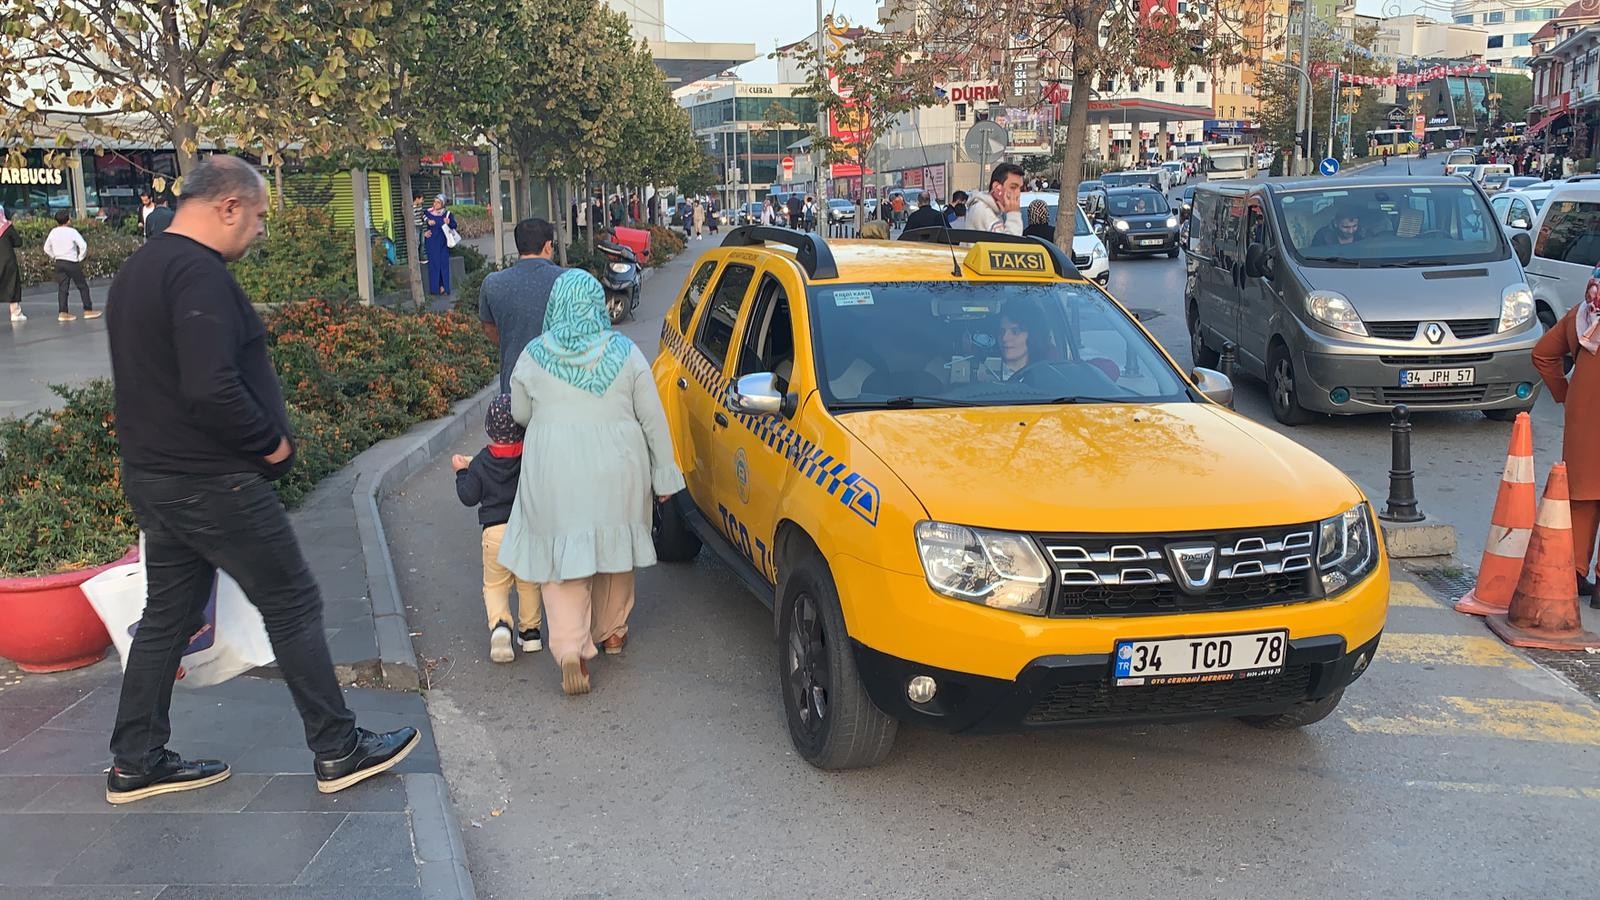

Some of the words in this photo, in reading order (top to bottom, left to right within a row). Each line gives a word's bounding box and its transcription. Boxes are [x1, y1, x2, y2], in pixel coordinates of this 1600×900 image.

[0, 167, 62, 184] ARBUCKS
[1407, 372, 1421, 383] 34
[1428, 371, 1450, 382] JPH
[1457, 370, 1471, 381] 57
[718, 502, 755, 562] TCD
[1133, 644, 1162, 673] 34
[1189, 640, 1232, 670] TCD
[1254, 635, 1283, 665] 78
[1118, 661, 1130, 671] TR
